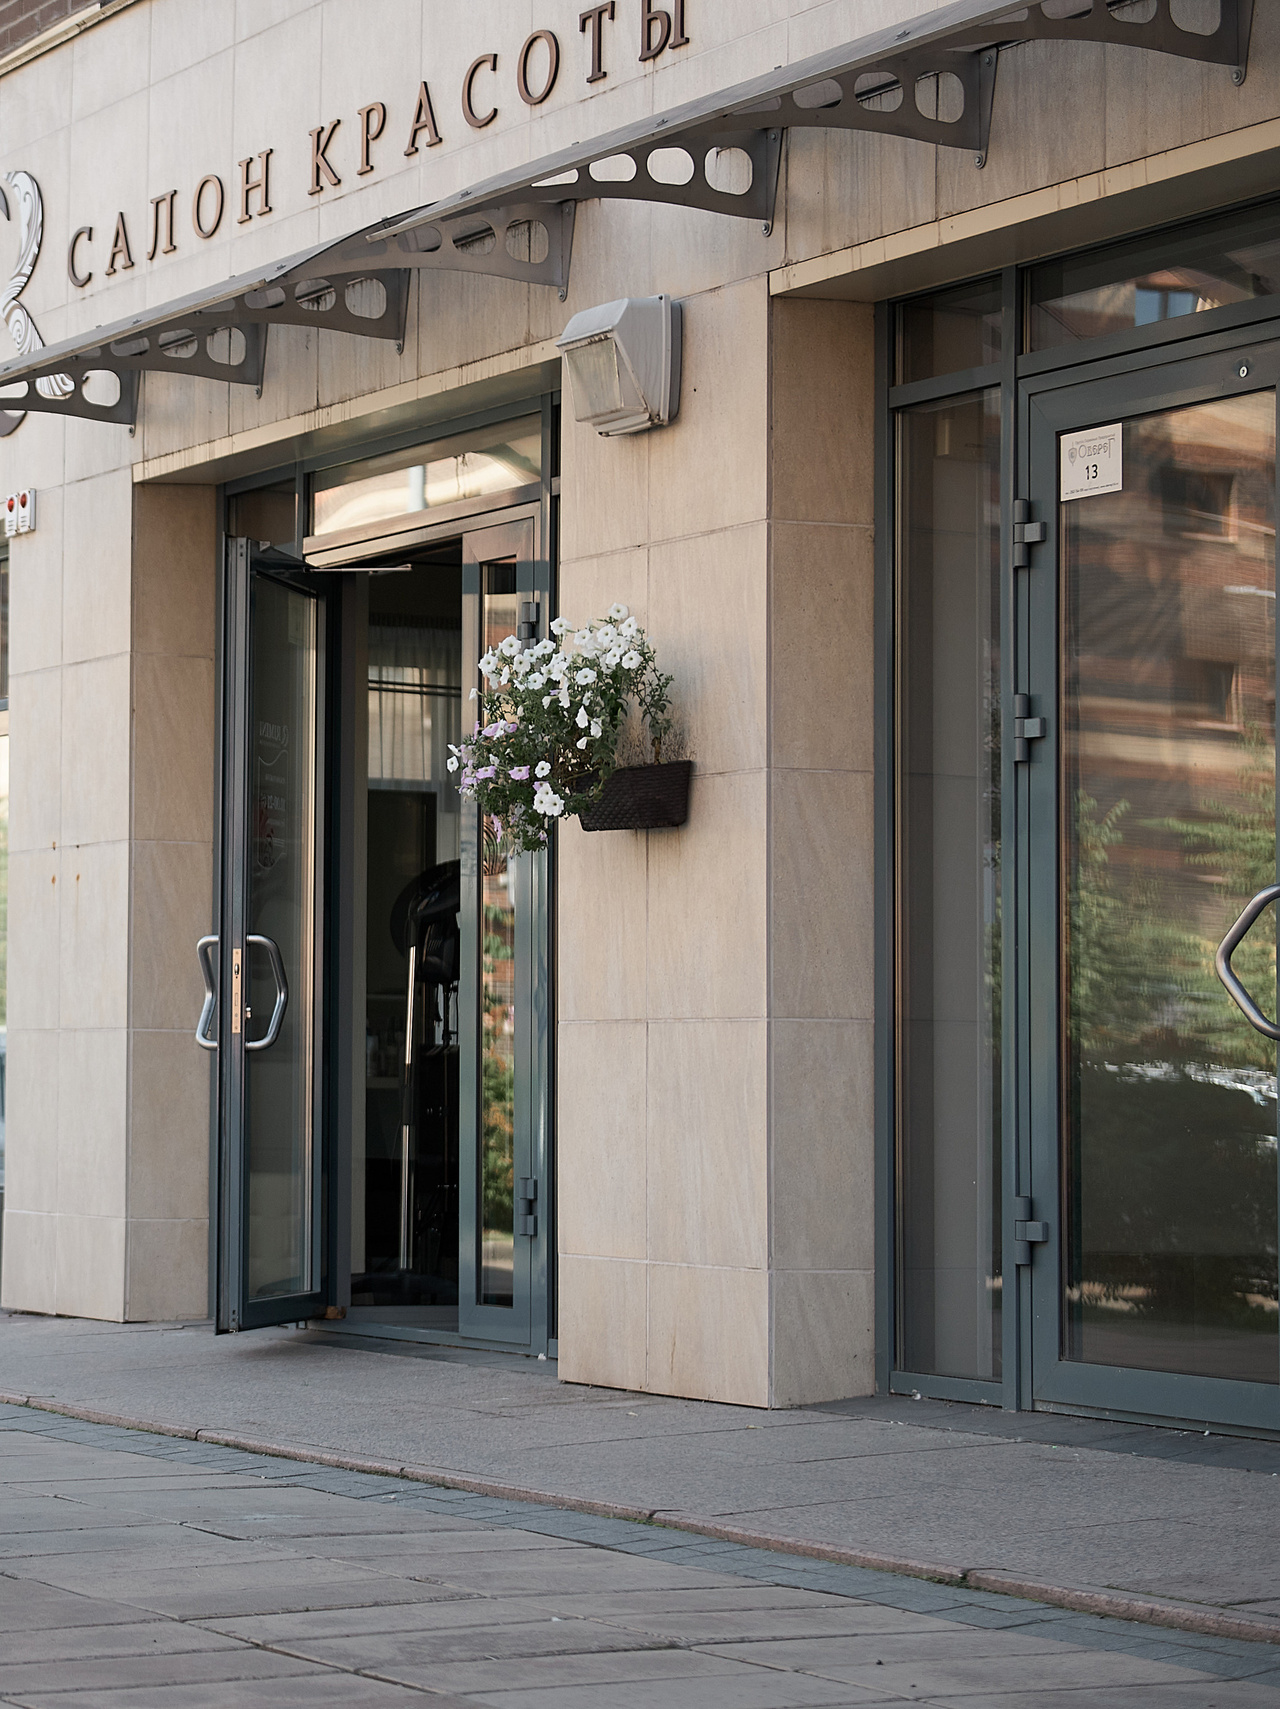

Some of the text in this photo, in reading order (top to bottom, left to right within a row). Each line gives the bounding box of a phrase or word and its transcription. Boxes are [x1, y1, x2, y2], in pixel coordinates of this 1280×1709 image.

[67, 0, 690, 287] САЛОН КРАСОТЫ
[1085, 463, 1098, 480] 13
